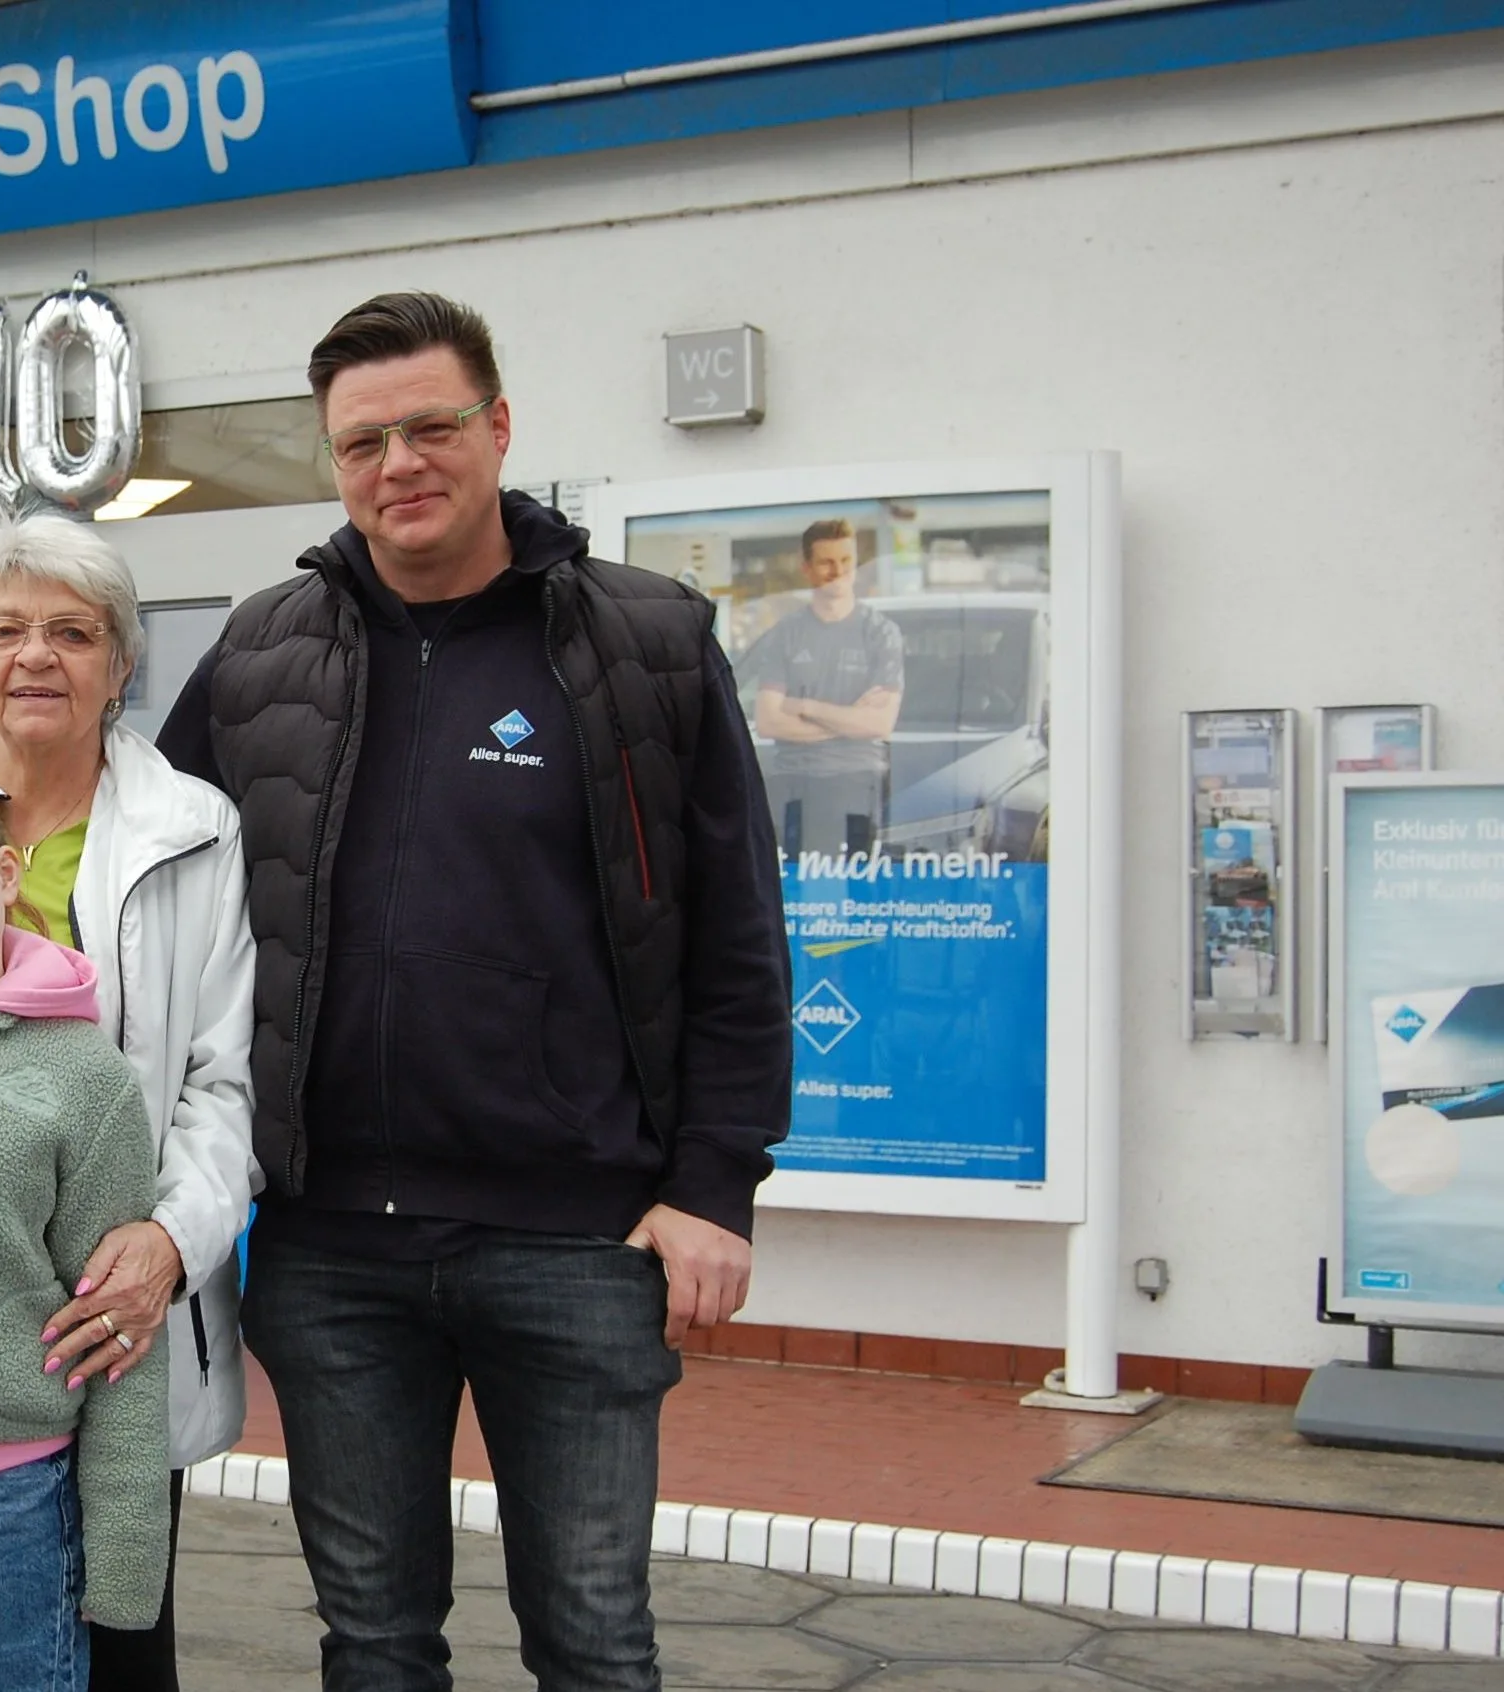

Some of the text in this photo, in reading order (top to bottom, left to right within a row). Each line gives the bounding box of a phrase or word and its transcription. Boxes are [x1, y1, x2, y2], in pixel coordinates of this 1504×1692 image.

[680, 345, 734, 382] WC
[496, 722, 528, 735] ARAL
[468, 747, 545, 768] Alles super.
[1373, 818, 1468, 842] Exklusiv
[797, 840, 894, 883] mich
[903, 845, 1013, 880] mehr.
[1372, 877, 1419, 900] Aral
[842, 899, 993, 920] Beschleunigung
[799, 919, 889, 938] ultimate
[797, 1004, 851, 1025] ARAL
[796, 1080, 893, 1101] Alles super.
